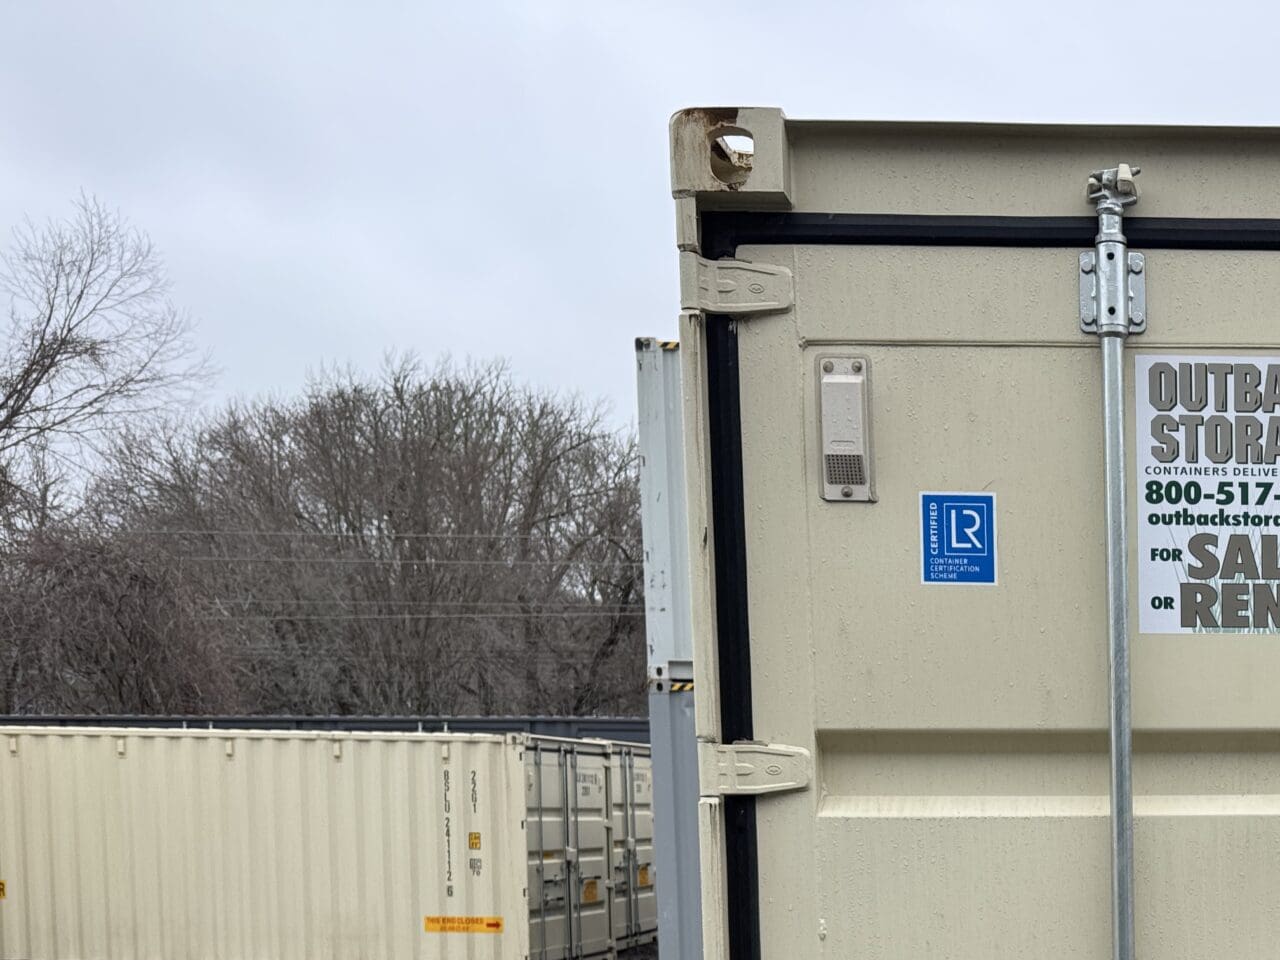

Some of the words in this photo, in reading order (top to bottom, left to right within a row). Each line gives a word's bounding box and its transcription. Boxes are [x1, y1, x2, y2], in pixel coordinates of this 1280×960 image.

[1145, 466, 1228, 476] CONTAINERS
[930, 502, 939, 555] CERTIFIED
[950, 509, 983, 548] LR
[1150, 548, 1183, 562] FOR
[1150, 597, 1174, 610] OR
[447, 886, 454, 897] 6
